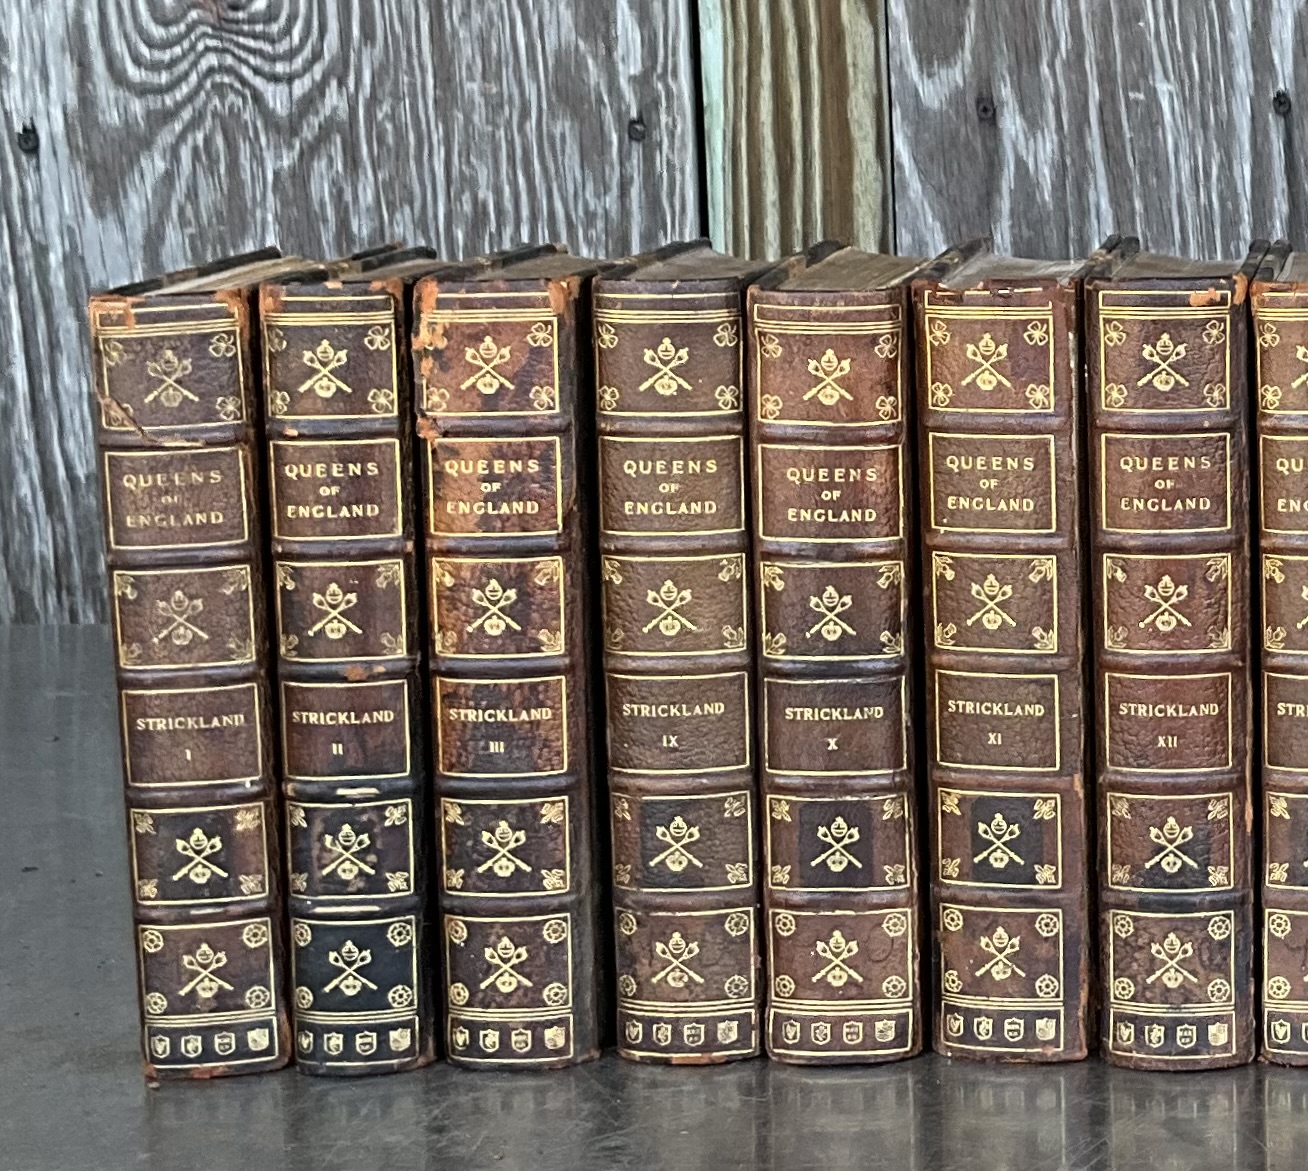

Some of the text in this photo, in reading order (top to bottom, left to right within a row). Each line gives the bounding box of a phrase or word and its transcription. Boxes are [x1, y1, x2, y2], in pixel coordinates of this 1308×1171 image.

[283, 461, 380, 480] QUEENS
[443, 459, 540, 476] QUEENS
[622, 459, 718, 477] QUEENS
[945, 455, 1035, 472] QUEENS
[1119, 455, 1212, 472] QUEENS
[122, 469, 223, 490] QUEENS
[786, 467, 878, 484] QUEENS
[318, 485, 340, 497] OF
[479, 482, 502, 494] OF
[658, 482, 680, 494] OF
[979, 478, 999, 490] OF
[1153, 478, 1176, 490] OF
[820, 489, 841, 501] OF
[286, 503, 380, 520] ENGLAND
[445, 500, 540, 516] ENGLAND
[623, 500, 717, 516] ENGLAND
[946, 496, 1035, 513] ENGLAND
[1120, 496, 1212, 512] ENGLAND
[125, 510, 225, 529] ENGLAND
[787, 507, 877, 523] ENGLAND
[448, 707, 553, 723] STRICKLAND
[622, 702, 726, 718] STRICKLAND
[784, 706, 884, 722] STRICKLAND
[947, 700, 1045, 717] STRICKLAND
[1118, 702, 1220, 718] STRICKLAND
[135, 714, 245, 731] STRICKLAND
[291, 710, 395, 725] STRICKLAND
[661, 734, 679, 747] IX
[826, 738, 839, 751] X
[987, 732, 1002, 745] XI
[1156, 735, 1178, 748] XII
[185, 749, 192, 761] I
[331, 743, 343, 755] II
[488, 741, 505, 753] III
